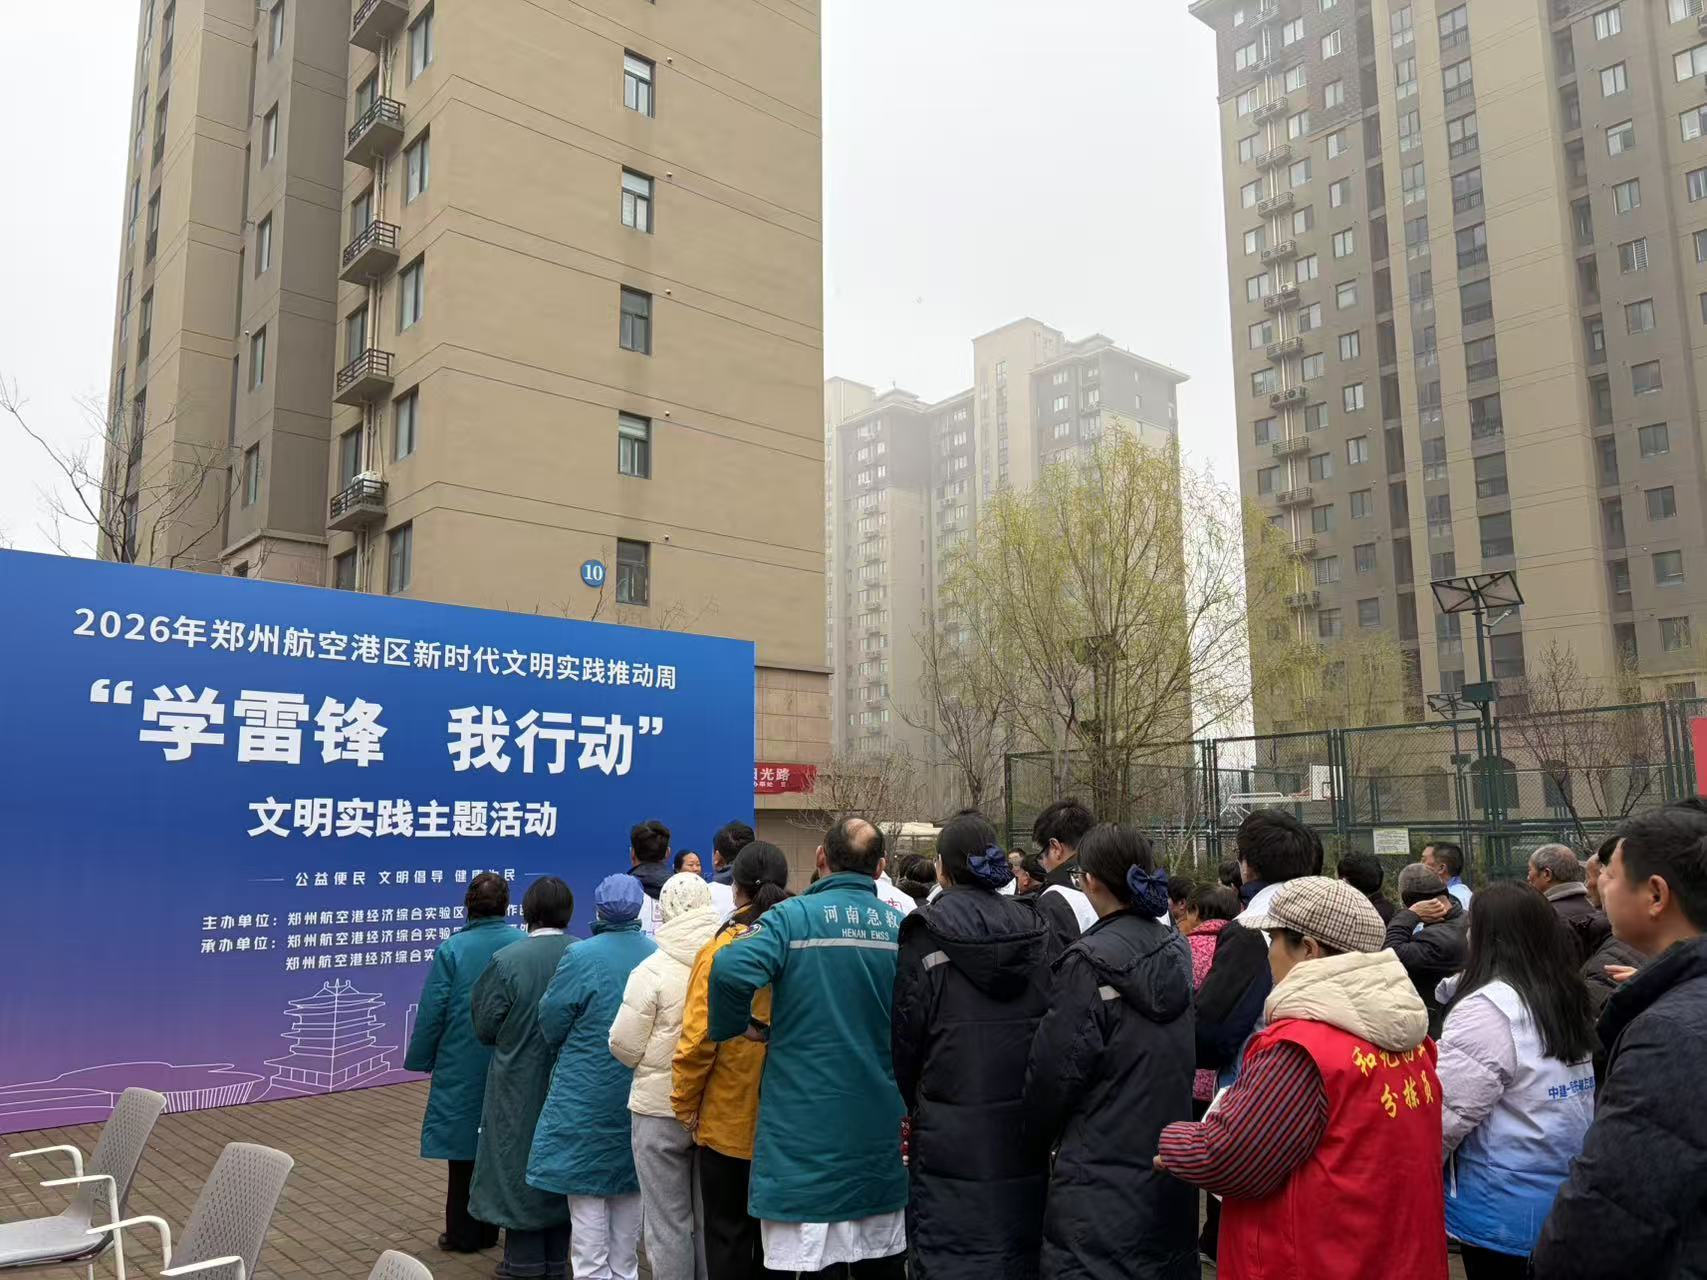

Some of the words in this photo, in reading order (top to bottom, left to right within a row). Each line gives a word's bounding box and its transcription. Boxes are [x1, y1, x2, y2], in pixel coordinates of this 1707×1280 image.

[584, 564, 603, 580] 10
[73, 608, 676, 689] 2026年郑州航空港区新时代文明实践推动周
[247, 796, 557, 838] 文明实践主题活动
[295, 872, 367, 887] 公益便民
[378, 870, 443, 885] 文明倡导
[823, 904, 900, 929] 河南急救
[841, 928, 866, 939] HENAN
